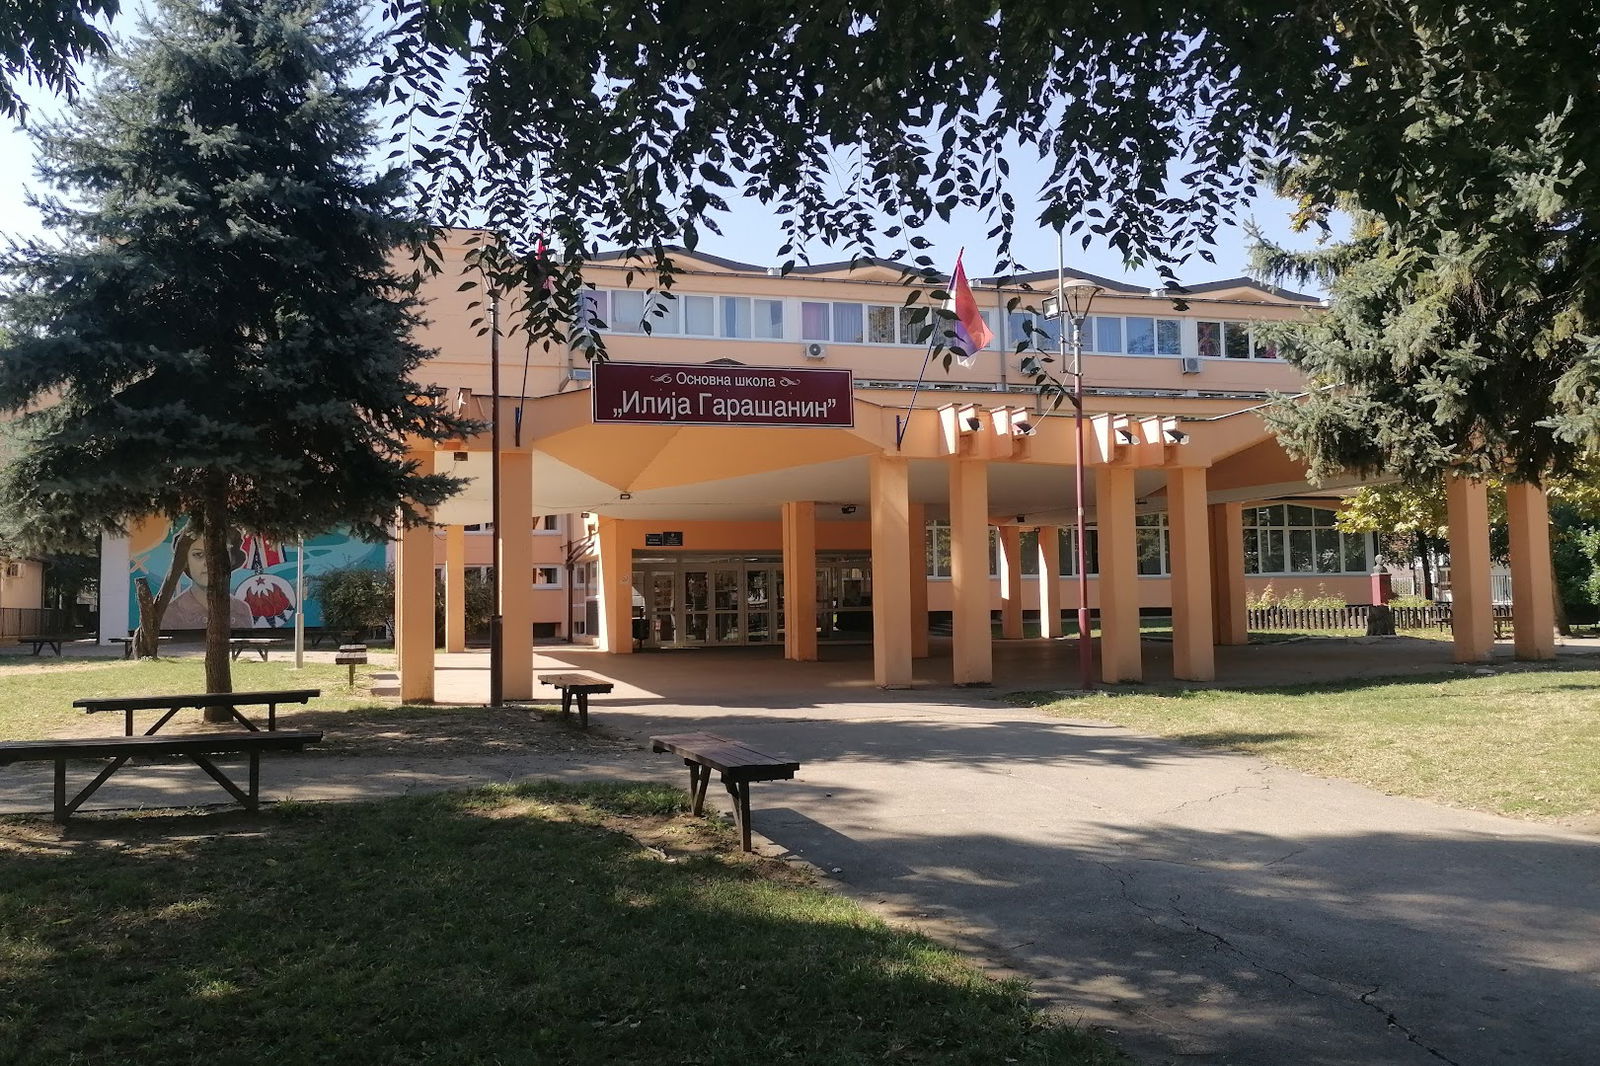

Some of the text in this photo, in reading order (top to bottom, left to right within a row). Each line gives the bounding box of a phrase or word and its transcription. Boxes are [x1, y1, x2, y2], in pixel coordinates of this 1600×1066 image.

[676, 372, 776, 388] Основна школа
[613, 390, 836, 421] „Илија Гарашанин”
